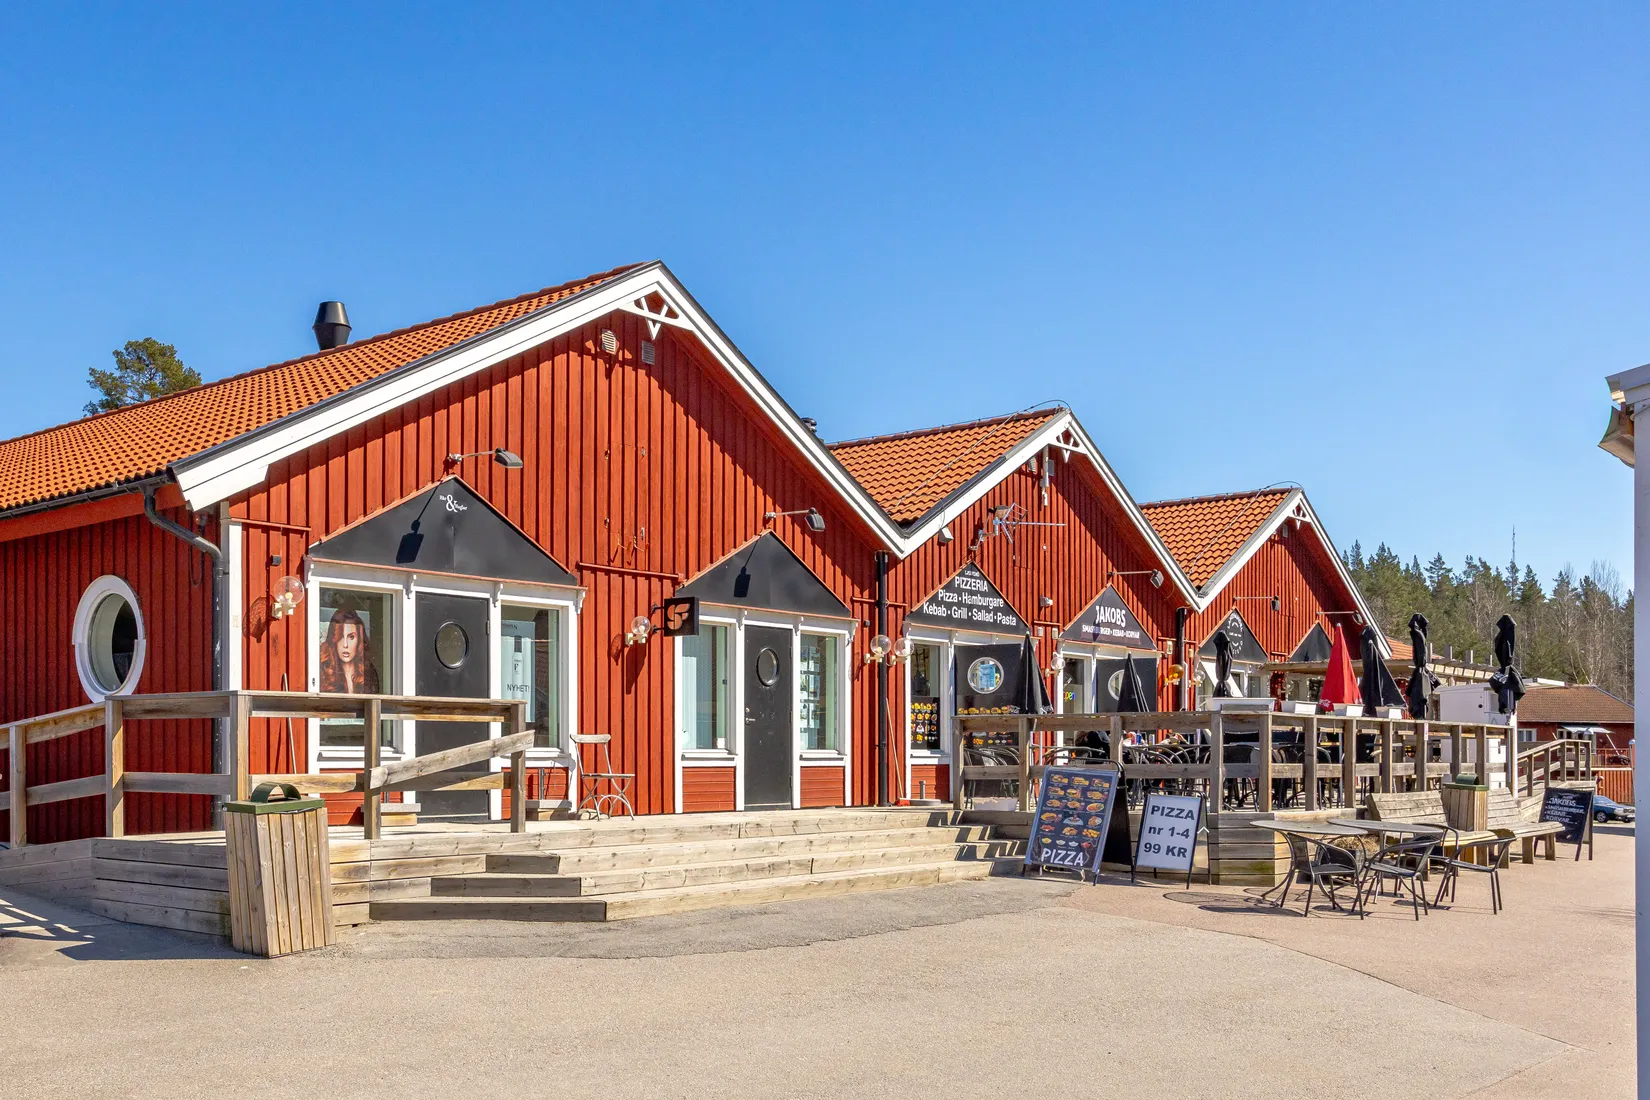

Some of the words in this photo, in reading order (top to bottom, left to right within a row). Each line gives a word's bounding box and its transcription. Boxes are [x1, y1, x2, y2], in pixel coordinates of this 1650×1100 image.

[955, 576, 988, 592] PIZZERIA
[939, 590, 957, 602] Pizza
[962, 592, 1004, 609] Hamburgare
[923, 602, 947, 617] Kebab
[952, 606, 967, 619] Grill
[972, 609, 993, 622] Sallad
[997, 613, 1016, 625] Pasta
[1096, 606, 1126, 627] JAKOBS
[507, 684, 530, 692] NYHET!
[1151, 805, 1195, 820] PIZZA
[1148, 825, 1164, 836] nr
[1168, 826, 1190, 839] 1-4
[1041, 847, 1084, 867] PIZZA
[1144, 842, 1162, 854] 99
[1165, 845, 1188, 859] KR
